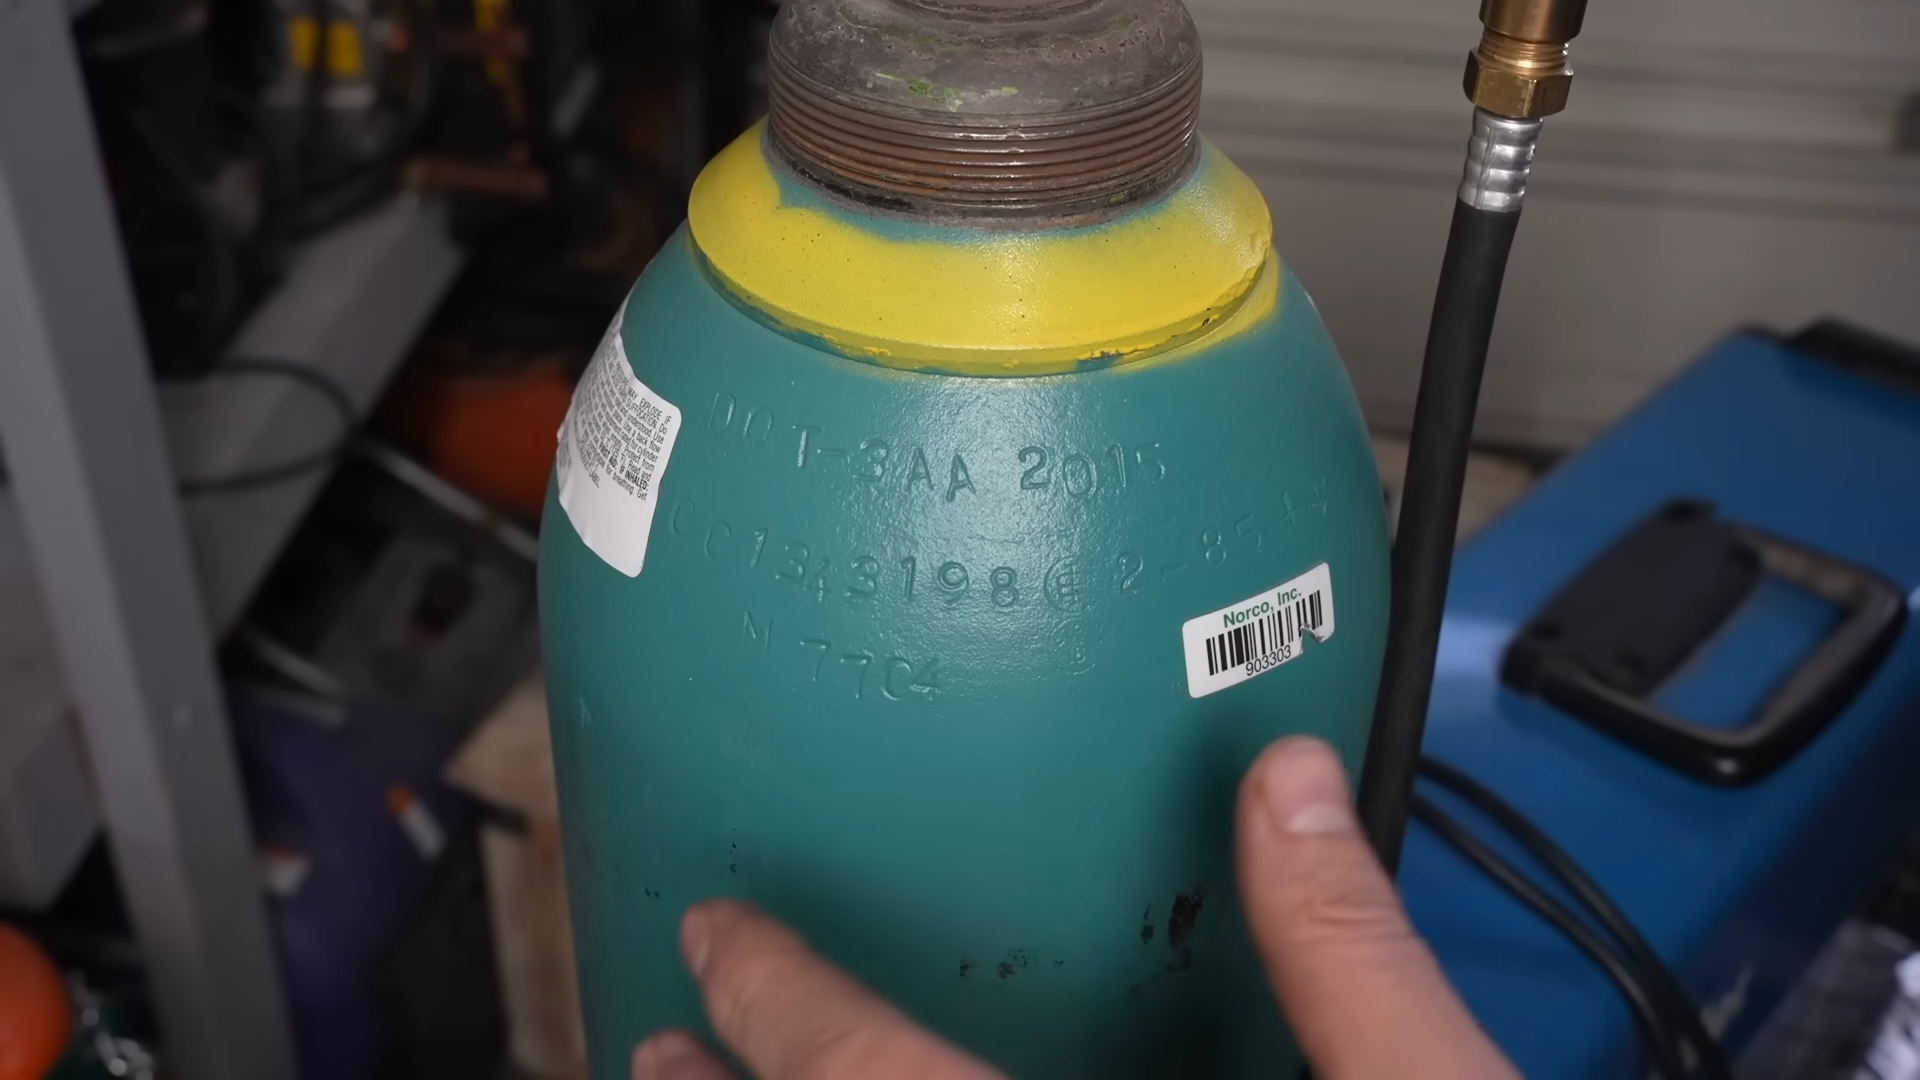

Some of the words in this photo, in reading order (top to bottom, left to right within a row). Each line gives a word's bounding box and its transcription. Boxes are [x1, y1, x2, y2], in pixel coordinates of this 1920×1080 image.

[1017, 442, 1167, 500] 2015
[1223, 601, 1274, 628] Norco,
[1277, 587, 1302, 607] Inc.
[1245, 644, 1292, 677] 903303
